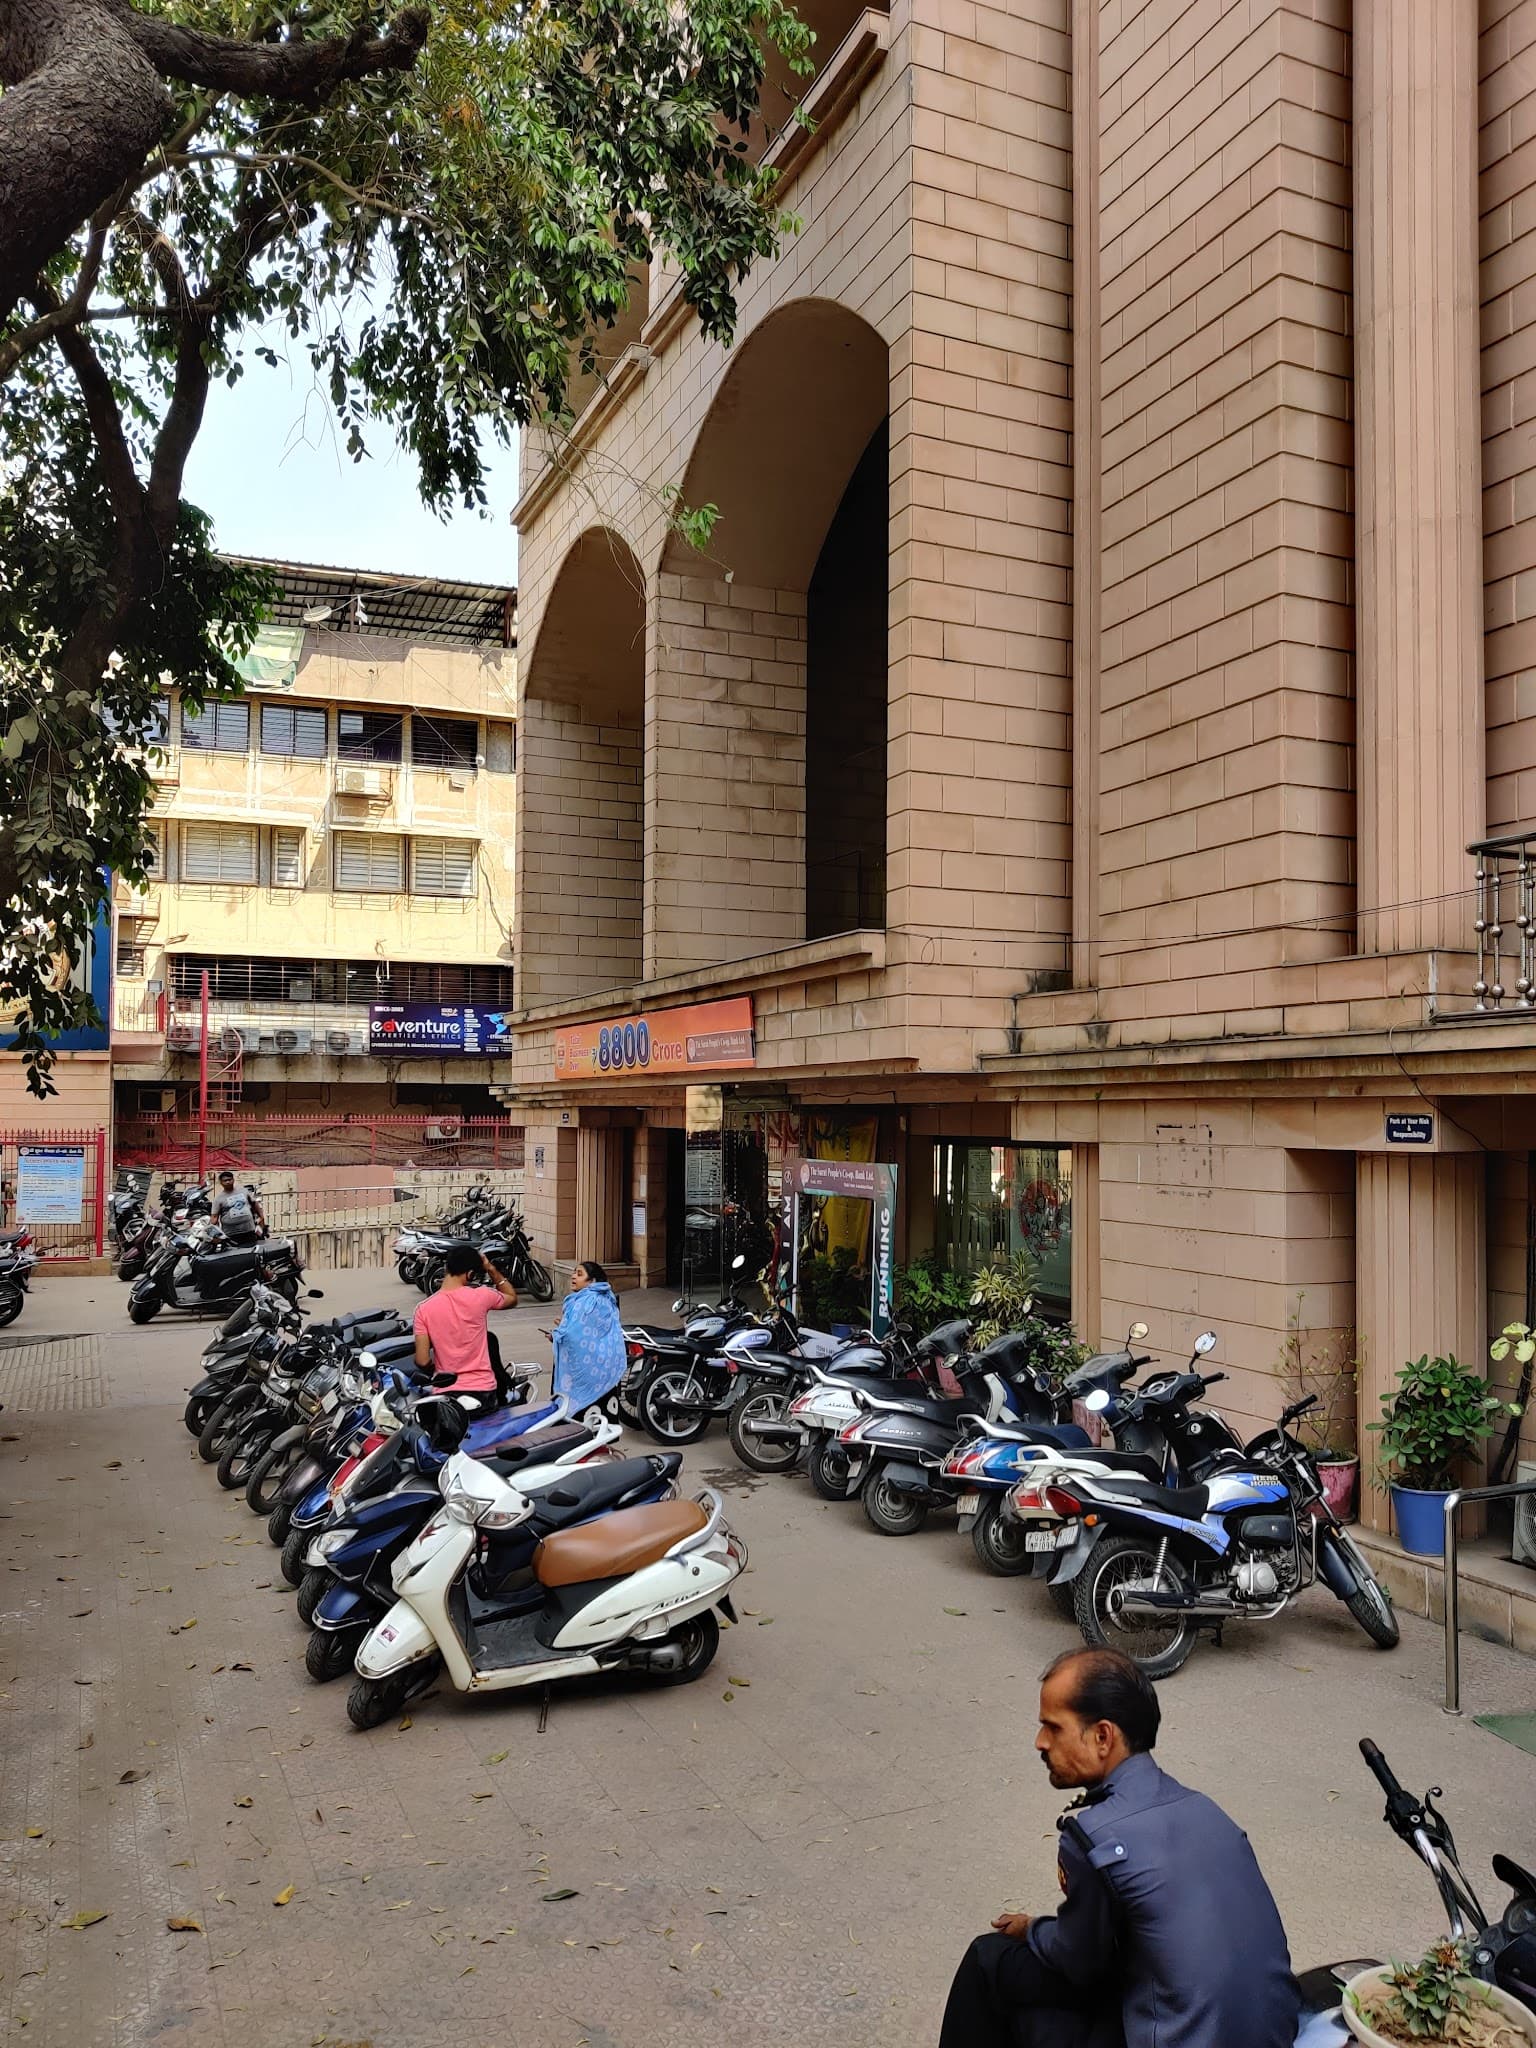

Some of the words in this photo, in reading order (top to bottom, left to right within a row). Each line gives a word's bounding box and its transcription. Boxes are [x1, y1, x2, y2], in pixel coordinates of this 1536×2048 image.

[598, 1020, 649, 1071] 8800
[652, 1039, 682, 1062] Crore
[1389, 1117, 1400, 1125] Park
[1393, 1131, 1427, 1139] Responsibility
[816, 1167, 827, 1177] Surat
[828, 1167, 841, 1181] People's
[855, 1169, 865, 1180] Bank
[784, 1195, 791, 1230] AM
[878, 1207, 890, 1318] RUNNING
